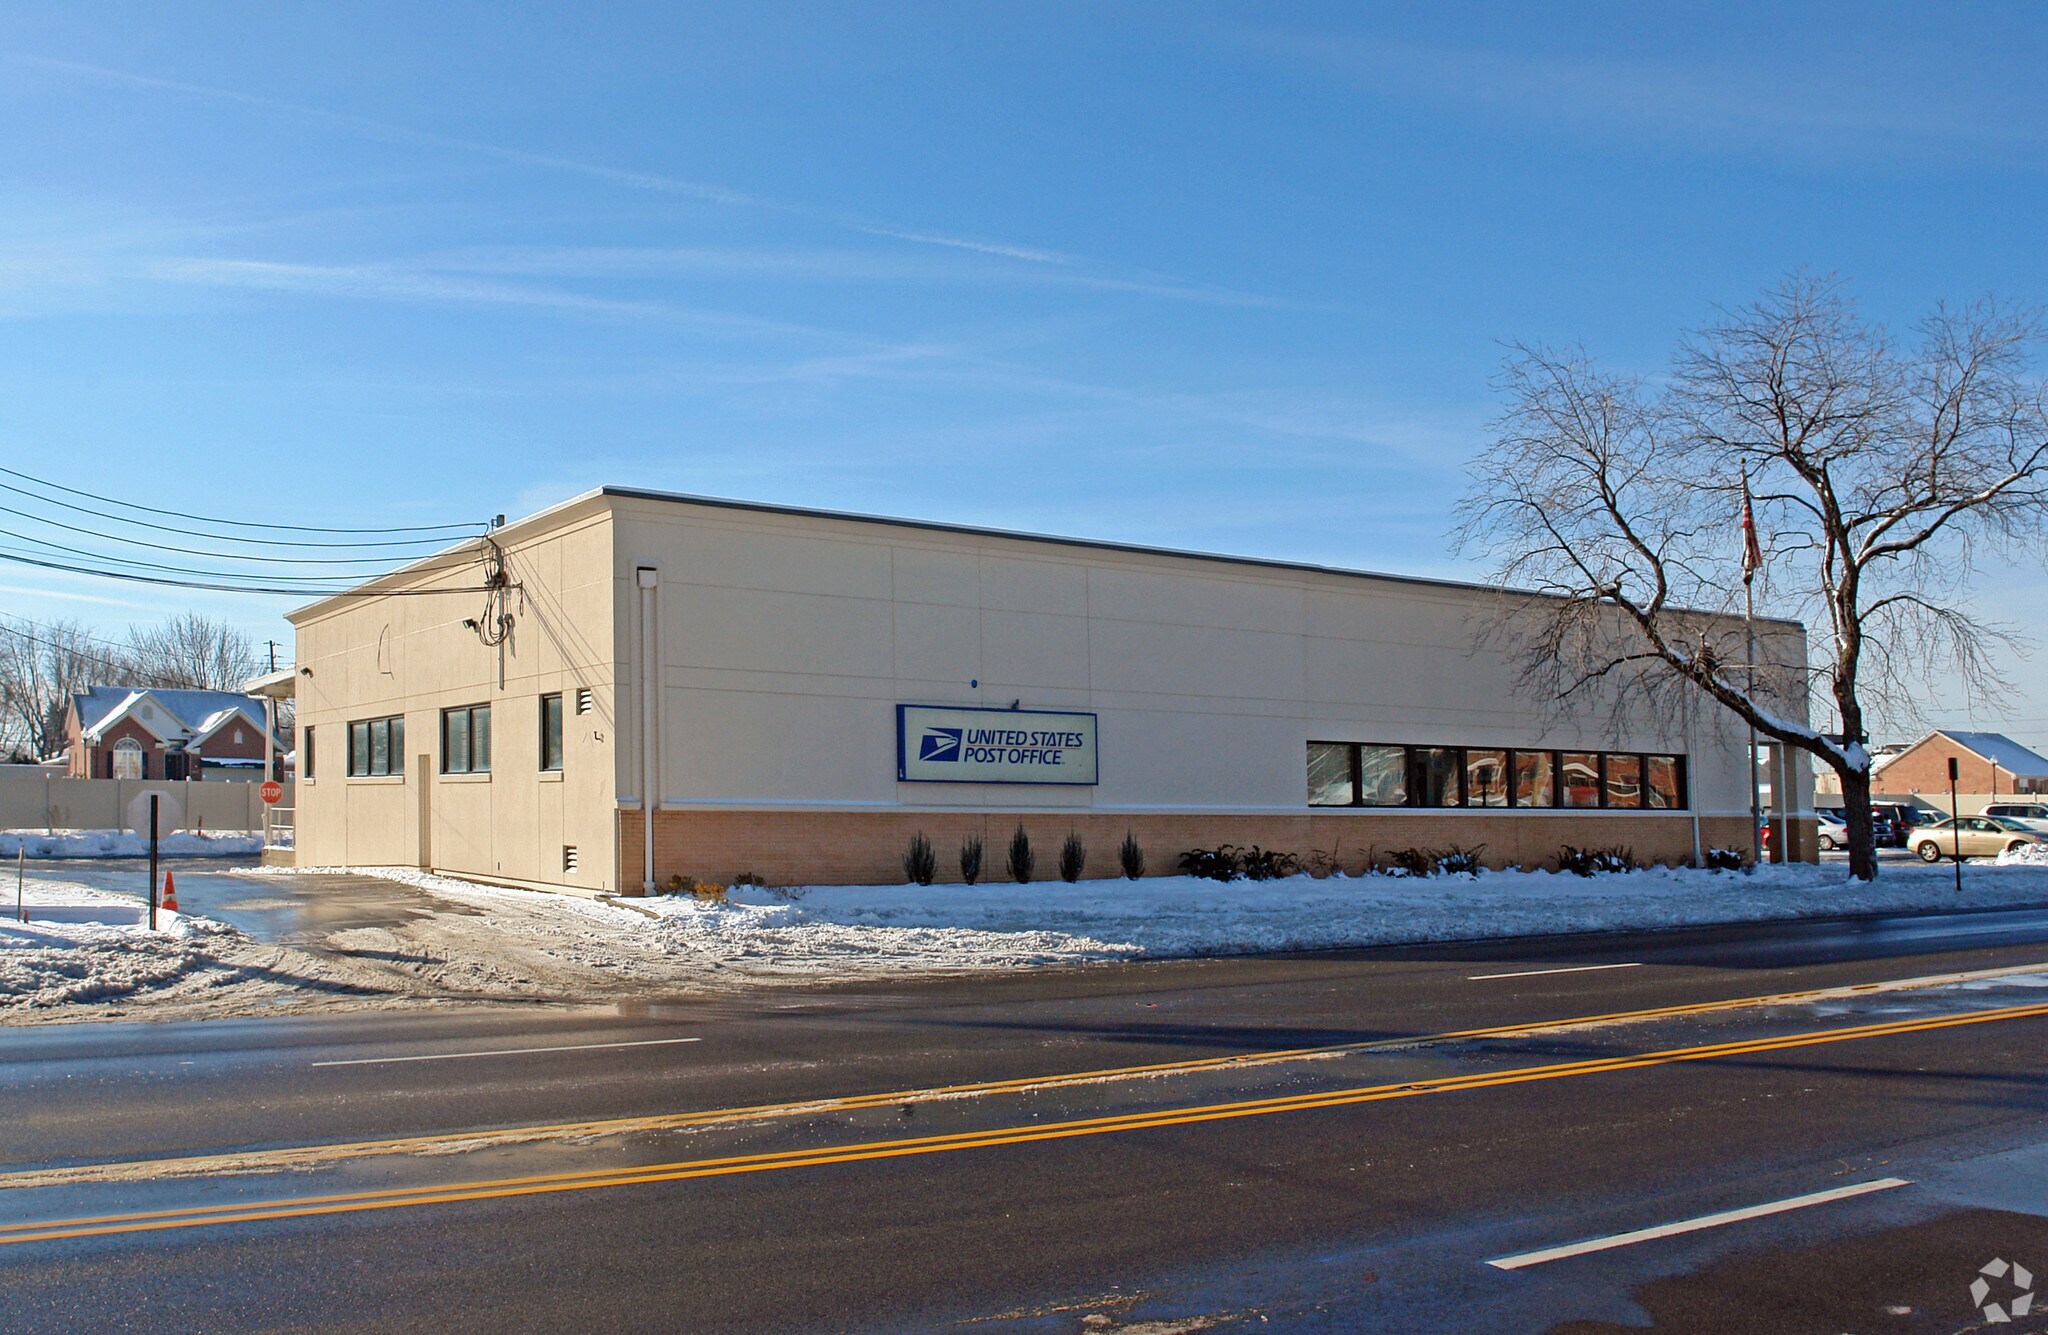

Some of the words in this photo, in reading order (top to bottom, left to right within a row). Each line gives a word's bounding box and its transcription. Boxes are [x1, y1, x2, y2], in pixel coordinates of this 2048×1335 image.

[967, 729, 1028, 746] UNITED
[1029, 731, 1083, 747] STATES
[964, 747, 1006, 763] POST
[1008, 748, 1062, 764] OFFICE
[261, 788, 281, 797] STOP
